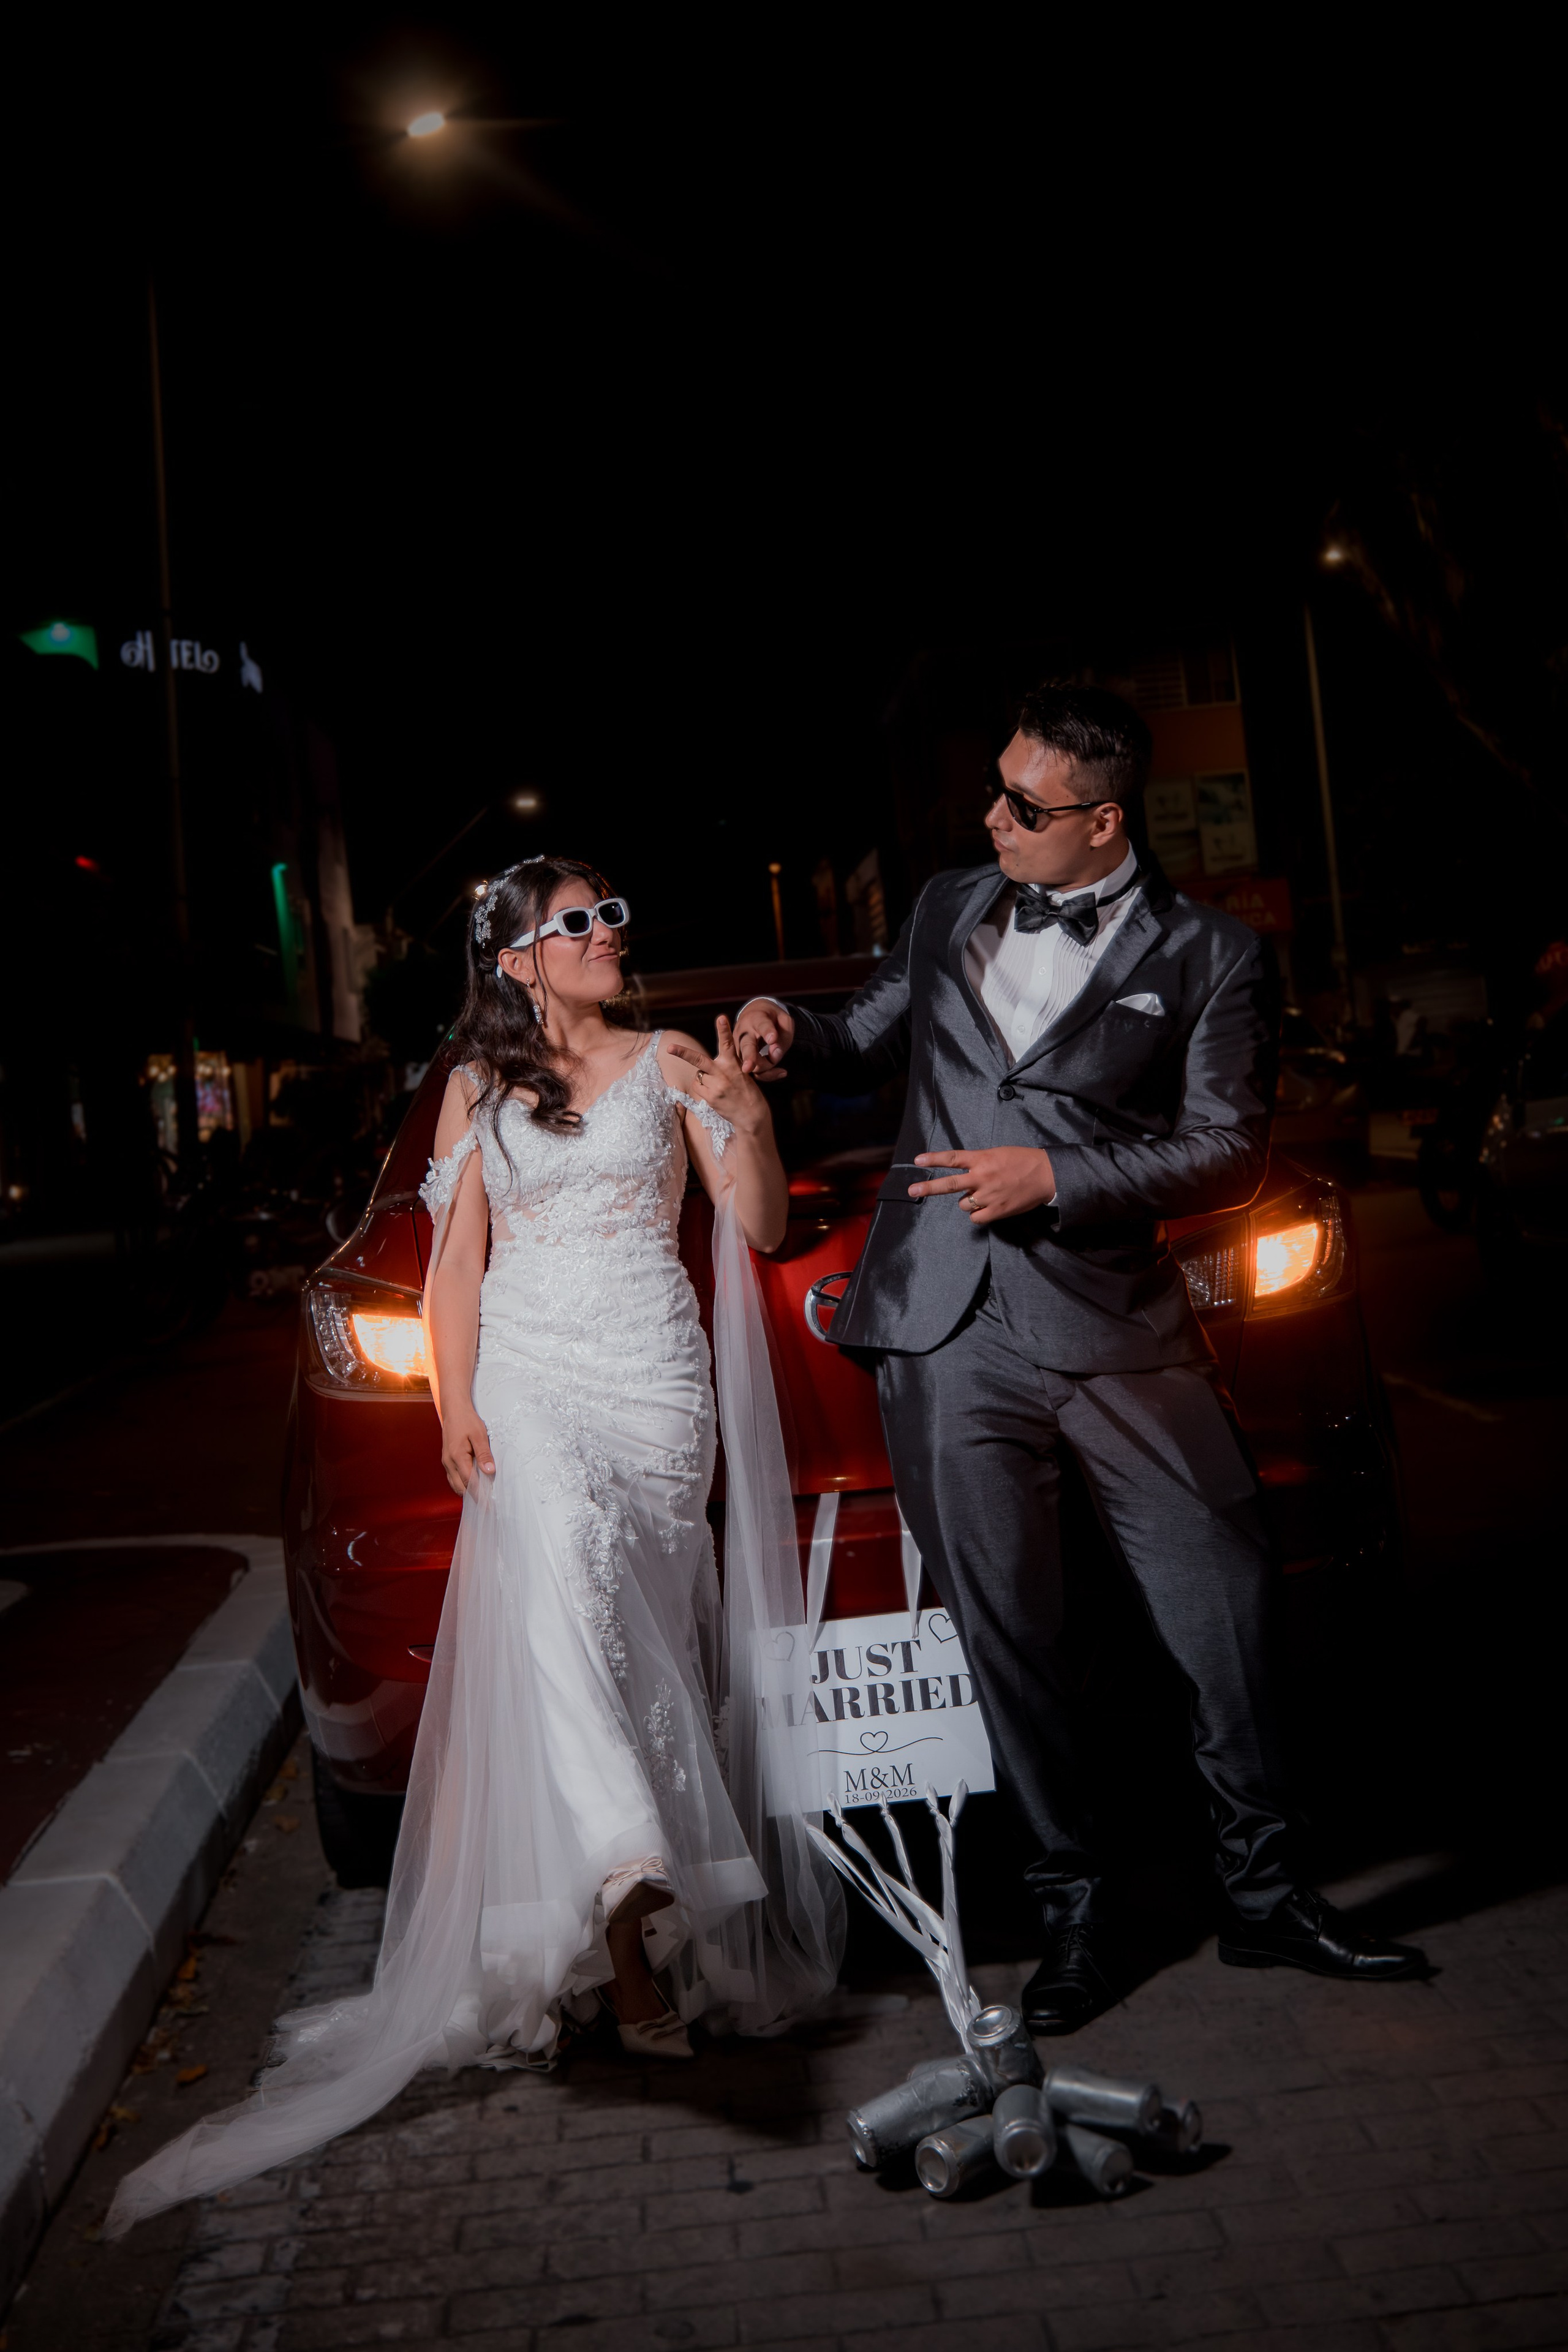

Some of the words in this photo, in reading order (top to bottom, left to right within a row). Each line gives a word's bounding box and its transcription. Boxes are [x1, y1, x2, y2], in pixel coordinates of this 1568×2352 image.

[119, 629, 221, 675] HTEL
[809, 1639, 922, 1684] JUST
[843, 1763, 916, 1793] M&M
[845, 1786, 917, 1804] 18-092026
